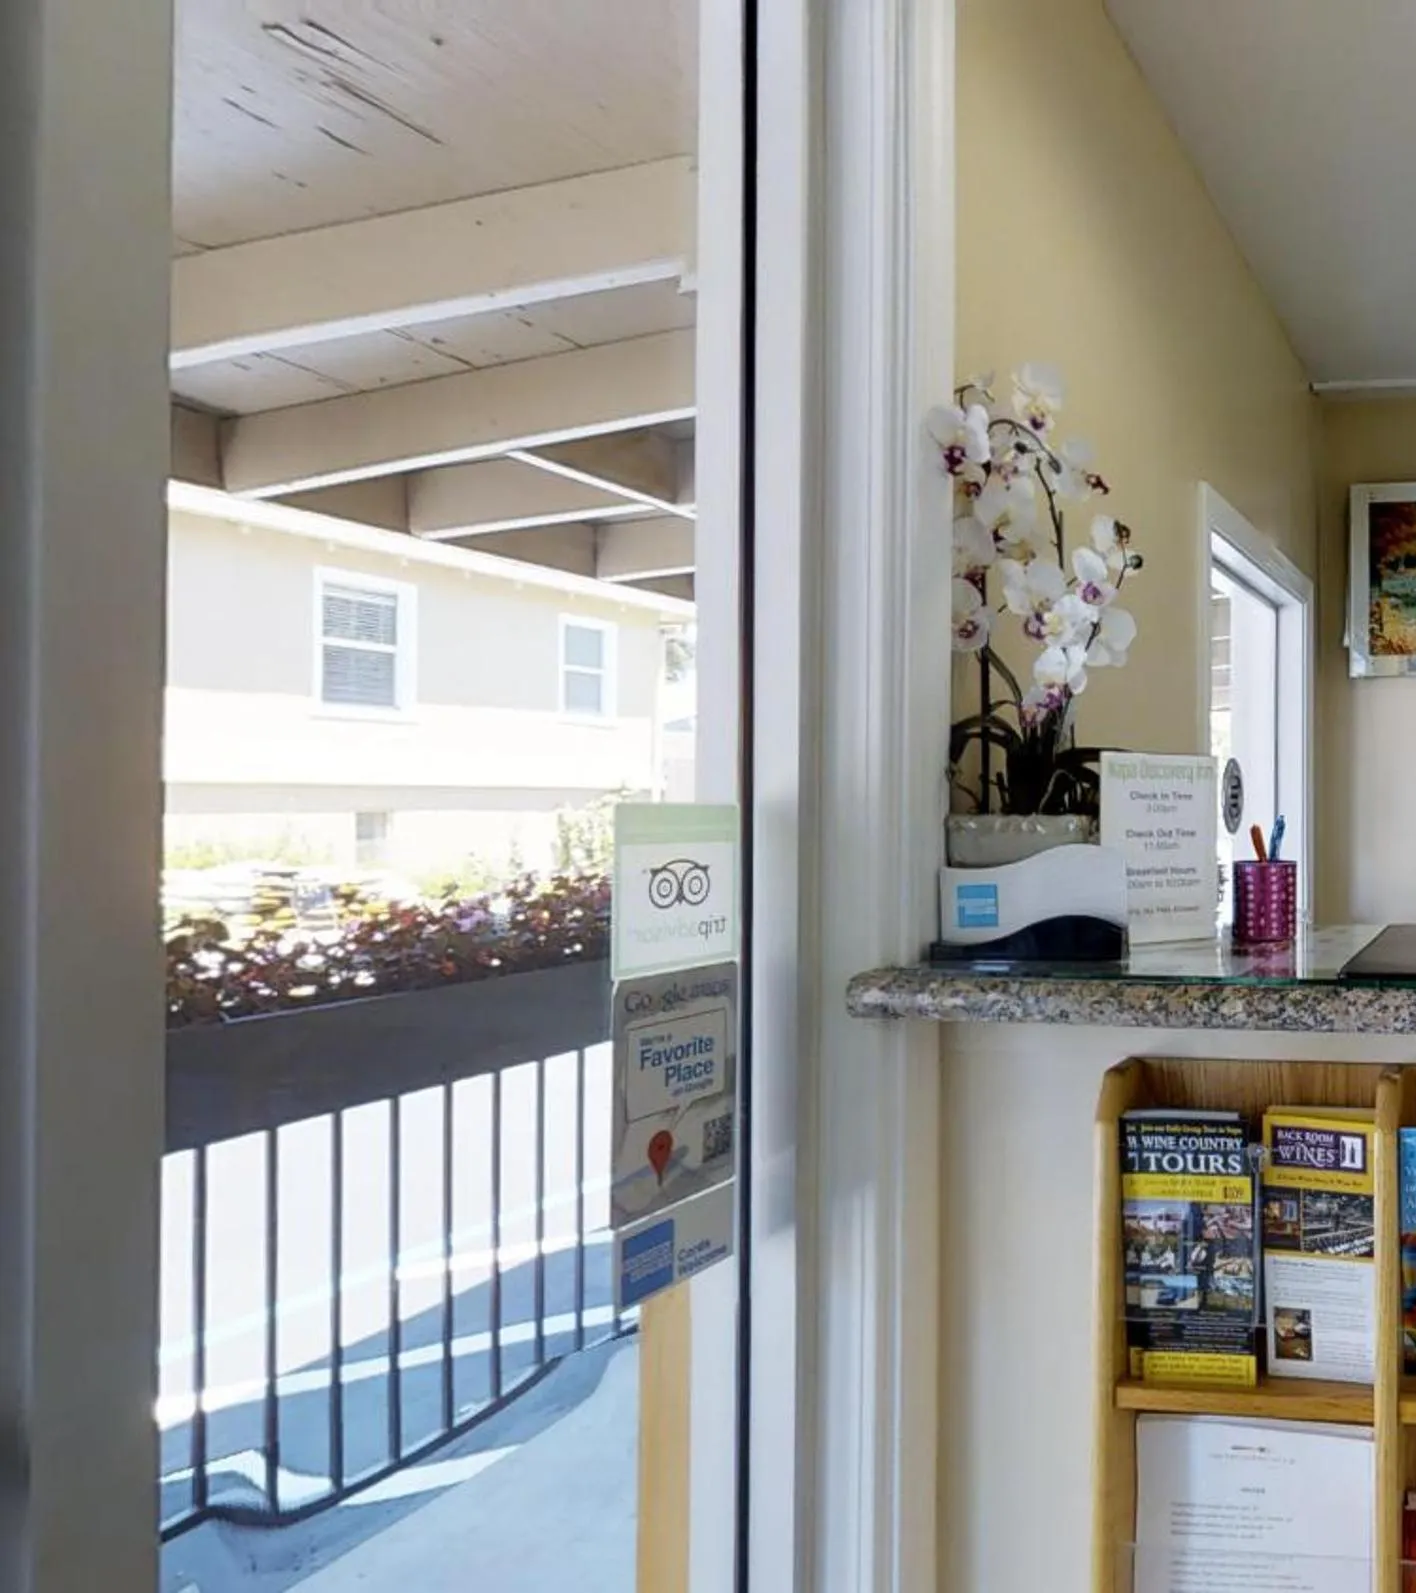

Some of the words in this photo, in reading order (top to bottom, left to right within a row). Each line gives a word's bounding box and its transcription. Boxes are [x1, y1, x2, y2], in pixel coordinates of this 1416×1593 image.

[1129, 790, 1157, 801] Check
[1125, 828, 1154, 839] Check
[639, 1036, 714, 1071] Favorite
[665, 1060, 714, 1087] Place
[1141, 1134, 1177, 1150] WINE
[1179, 1136, 1243, 1152] COUNTRY
[1304, 1131, 1335, 1143] ROOM
[1143, 1152, 1243, 1174] TOURS
[1278, 1142, 1337, 1168] WINES
